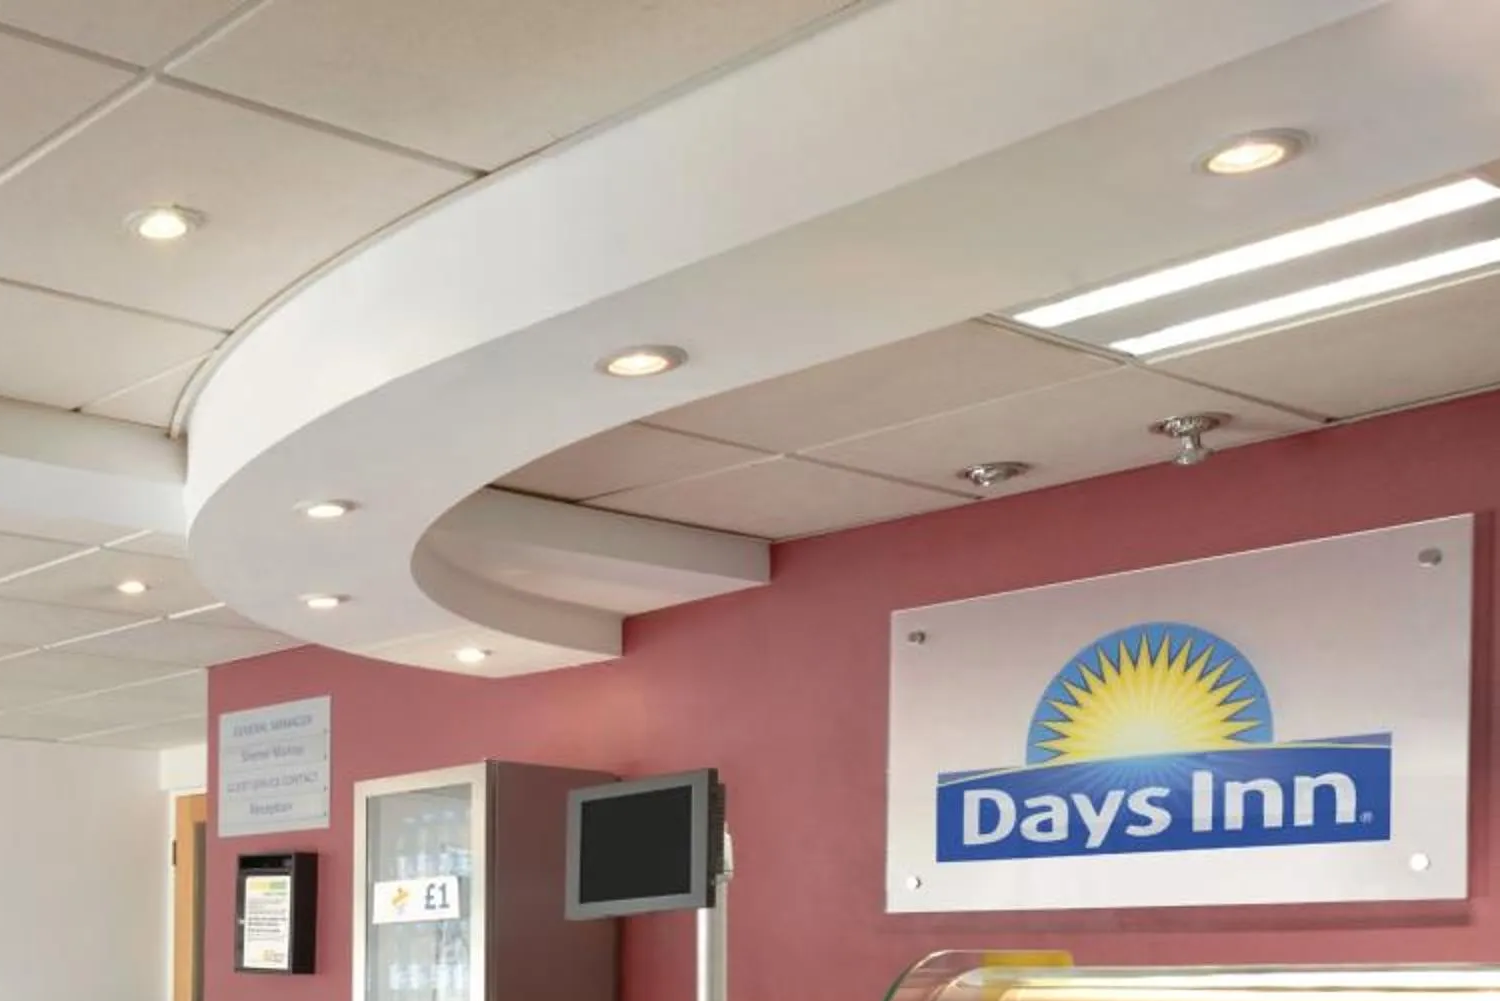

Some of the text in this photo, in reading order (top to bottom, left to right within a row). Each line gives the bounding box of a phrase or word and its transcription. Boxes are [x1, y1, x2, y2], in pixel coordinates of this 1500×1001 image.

[963, 769, 1358, 849] Days Inn
[424, 882, 450, 910] £1
